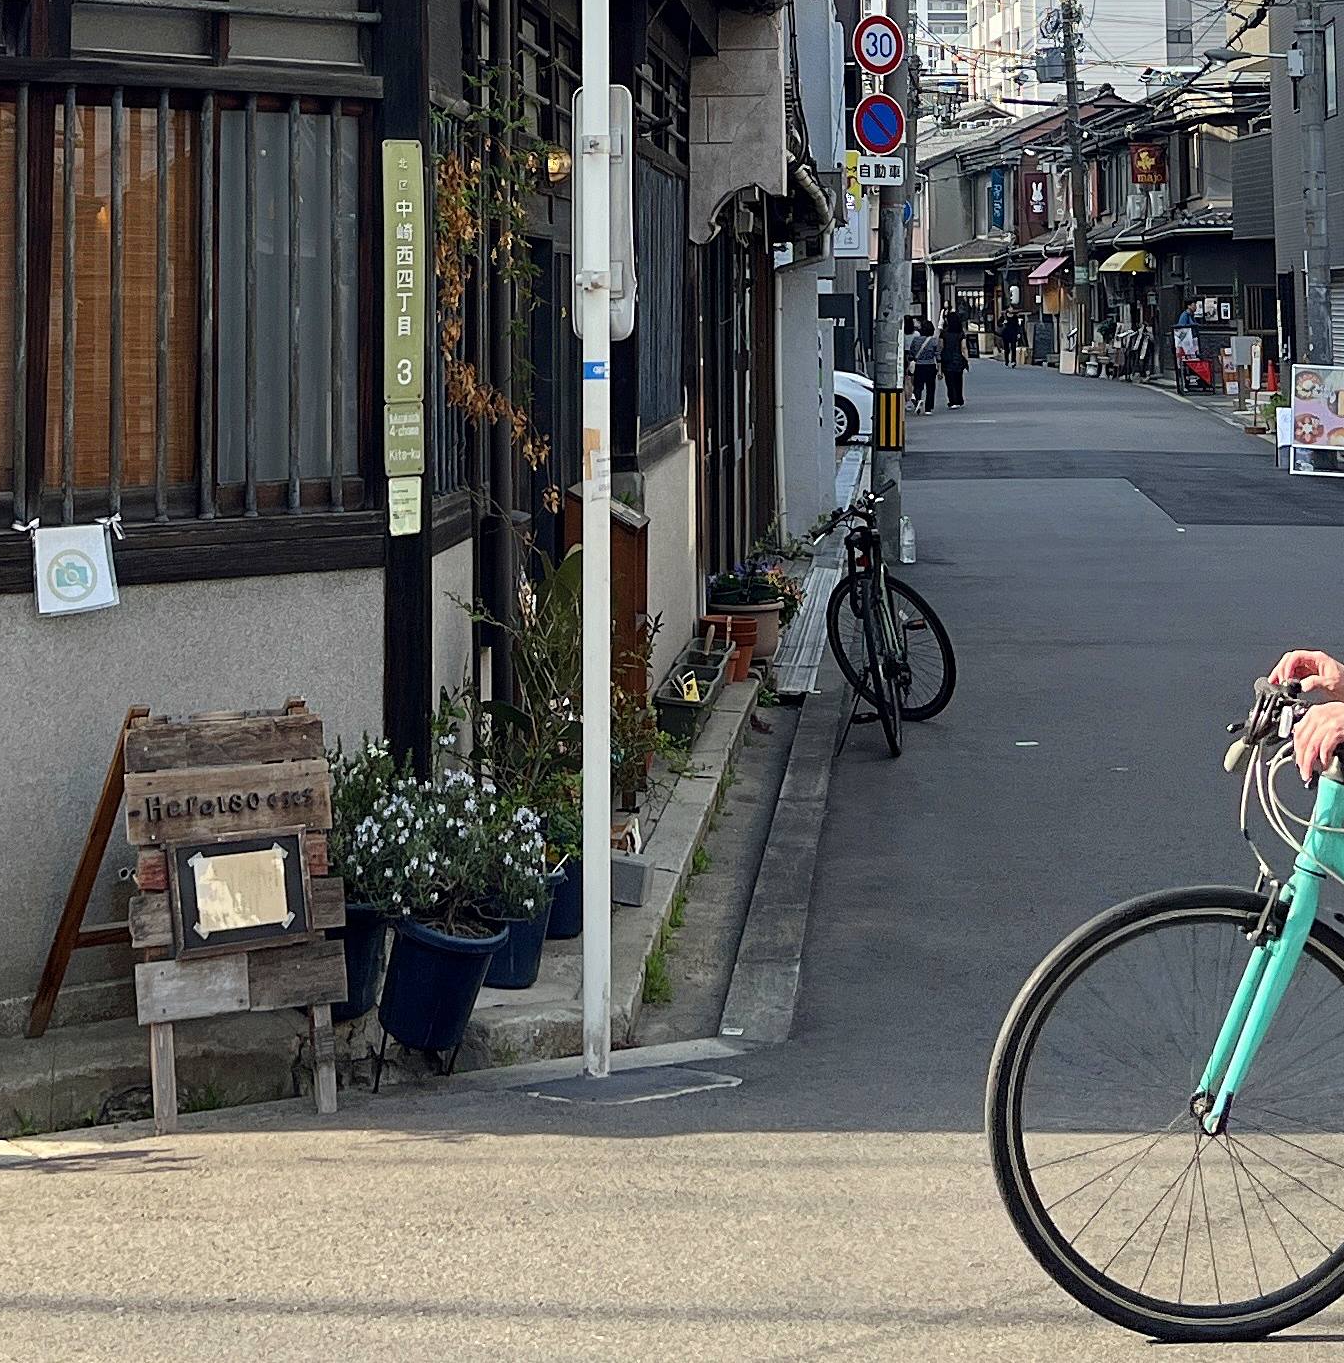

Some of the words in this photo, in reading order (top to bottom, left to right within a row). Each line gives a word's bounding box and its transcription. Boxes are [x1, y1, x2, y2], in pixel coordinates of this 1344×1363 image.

[865, 32, 893, 58] 30
[859, 163, 901, 179] 自動車
[1137, 173, 1163, 183] majo
[397, 358, 413, 385] 3
